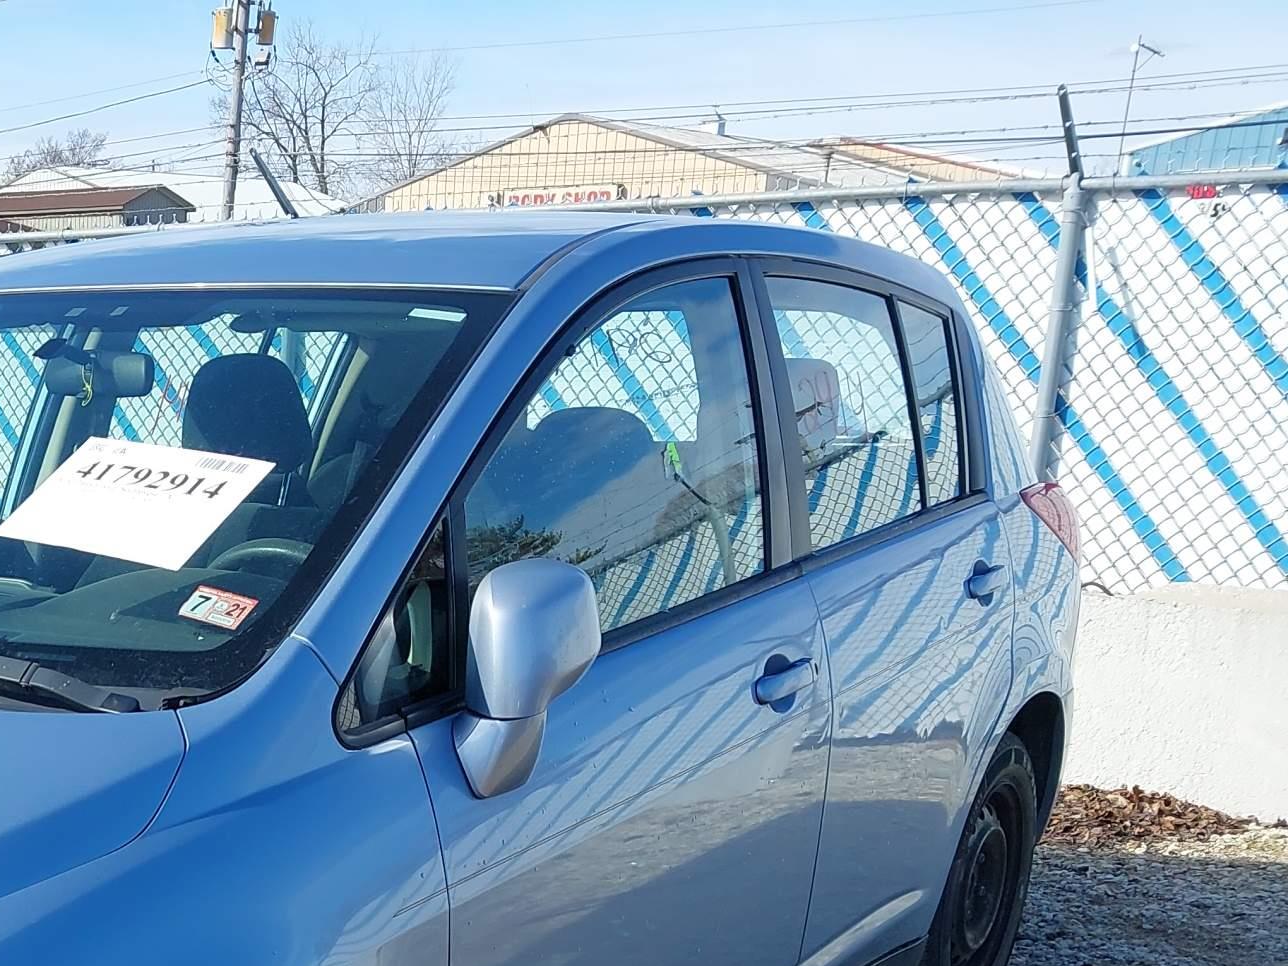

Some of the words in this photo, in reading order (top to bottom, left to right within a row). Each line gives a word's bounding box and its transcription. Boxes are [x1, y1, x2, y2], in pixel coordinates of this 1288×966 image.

[76, 461, 228, 499] 41792914
[190, 595, 212, 612] 7
[225, 603, 247, 618] 21
